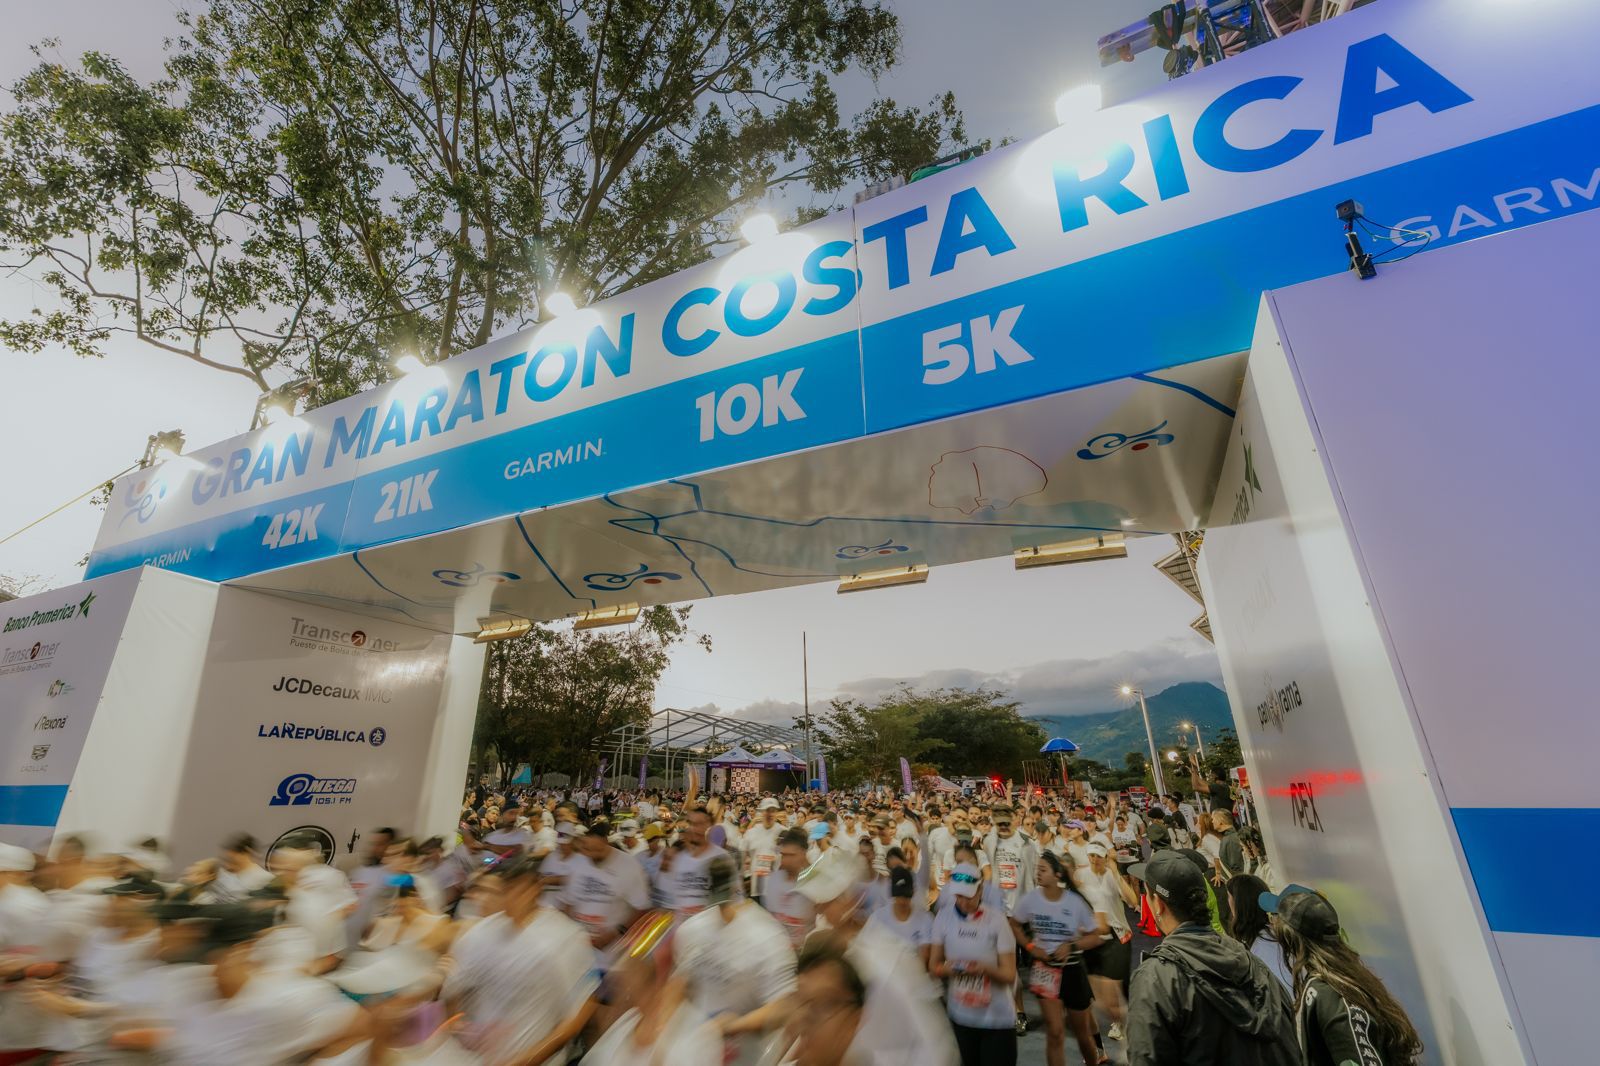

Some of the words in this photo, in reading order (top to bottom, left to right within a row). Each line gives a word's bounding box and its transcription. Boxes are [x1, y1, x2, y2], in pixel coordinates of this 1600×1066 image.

[191, 428, 315, 506] GRAN
[323, 312, 635, 469] MARATON
[662, 186, 1017, 357] COSTA
[1052, 32, 1475, 233] RICA
[922, 304, 1034, 386] 5K
[695, 367, 807, 442] 10K
[503, 438, 603, 481] GARMIN
[374, 469, 440, 523] 21K
[261, 503, 326, 550] 42K
[3, 616, 31, 634] Banco
[29, 603, 76, 627] Promerica
[291, 616, 401, 652] Transcomer
[289, 638, 317, 651] Puesto
[272, 676, 361, 701] JCDecaux
[39, 715, 67, 730] Rexona
[339, 797, 352, 805] FM
